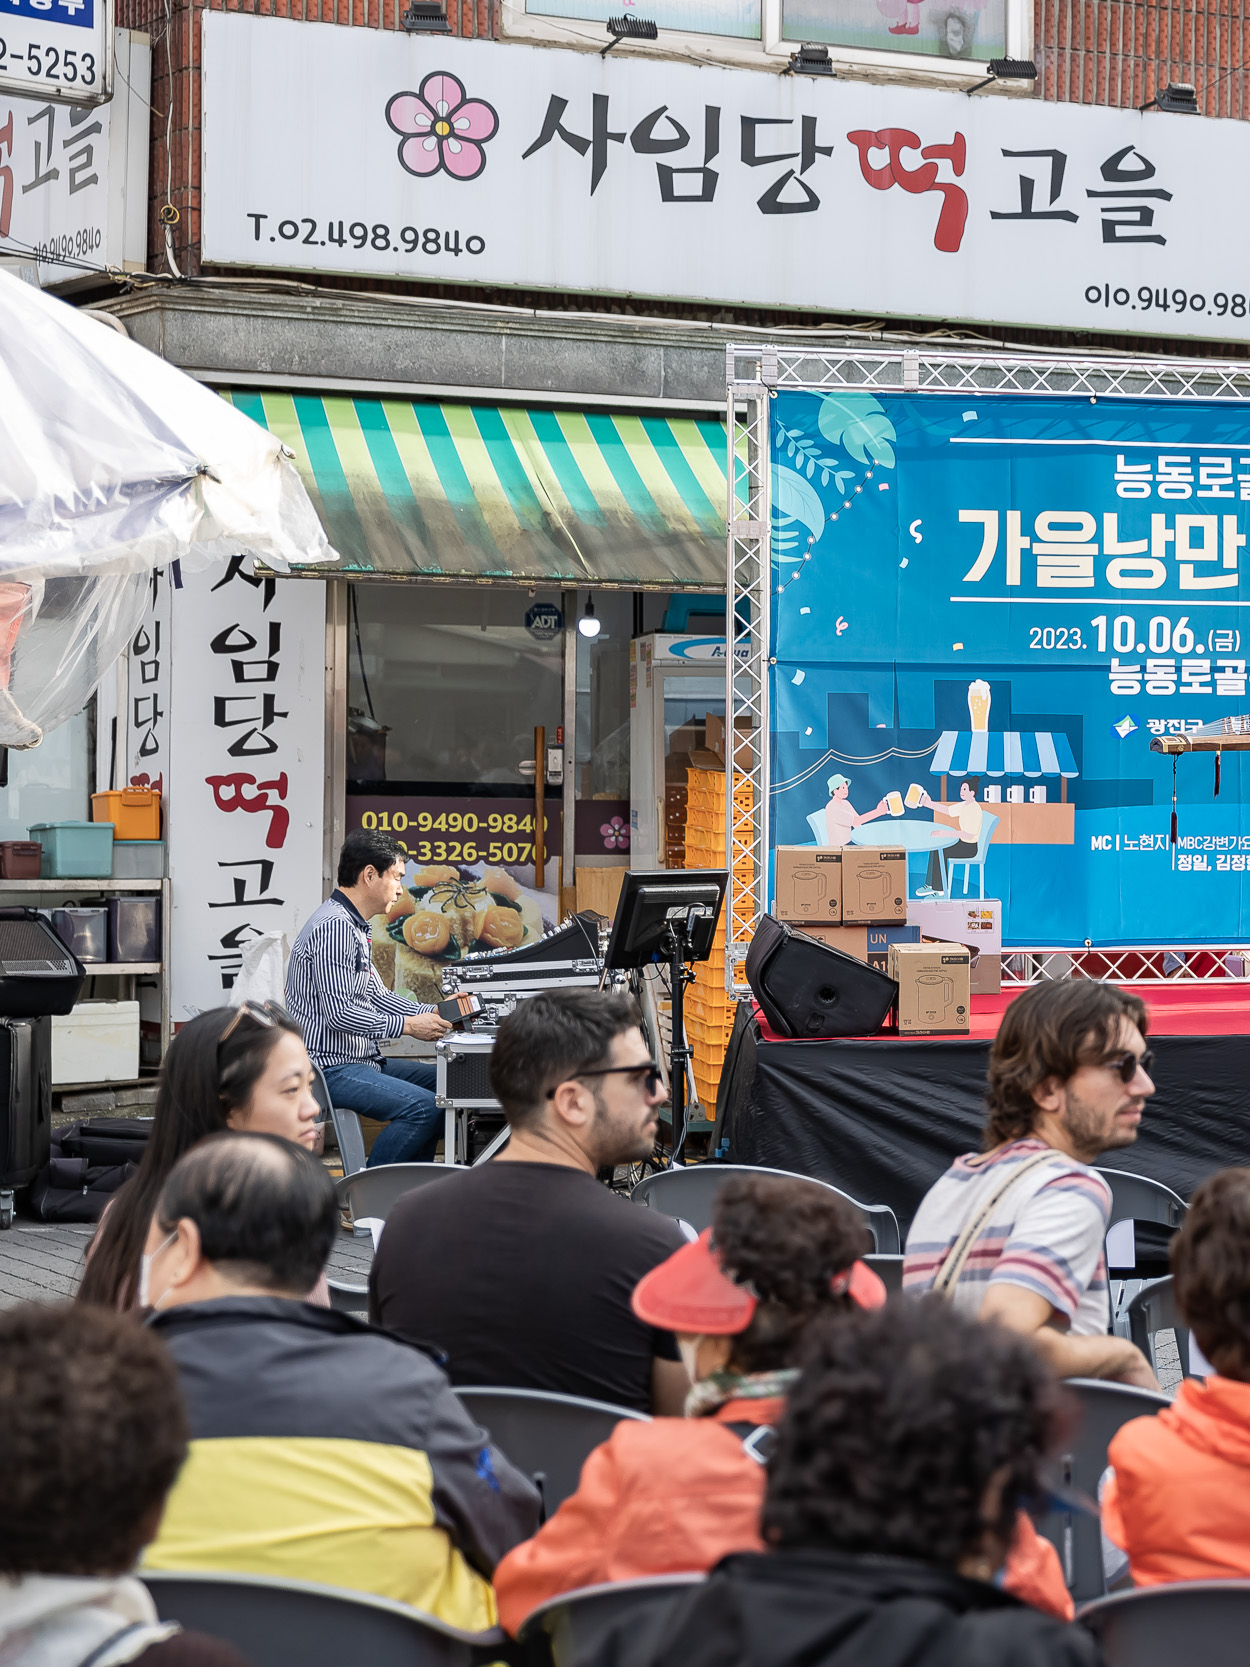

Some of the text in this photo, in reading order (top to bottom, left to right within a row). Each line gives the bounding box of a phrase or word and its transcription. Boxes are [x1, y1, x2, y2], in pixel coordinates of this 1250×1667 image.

[247, 213, 486, 256] T.02.498.9840
[957, 509, 1247, 591] 가을낭만
[530, 614, 558, 629] ADT
[1091, 835, 1113, 851] MC
[1123, 834, 1170, 851] 노현지
[870, 933, 887, 944] UN
